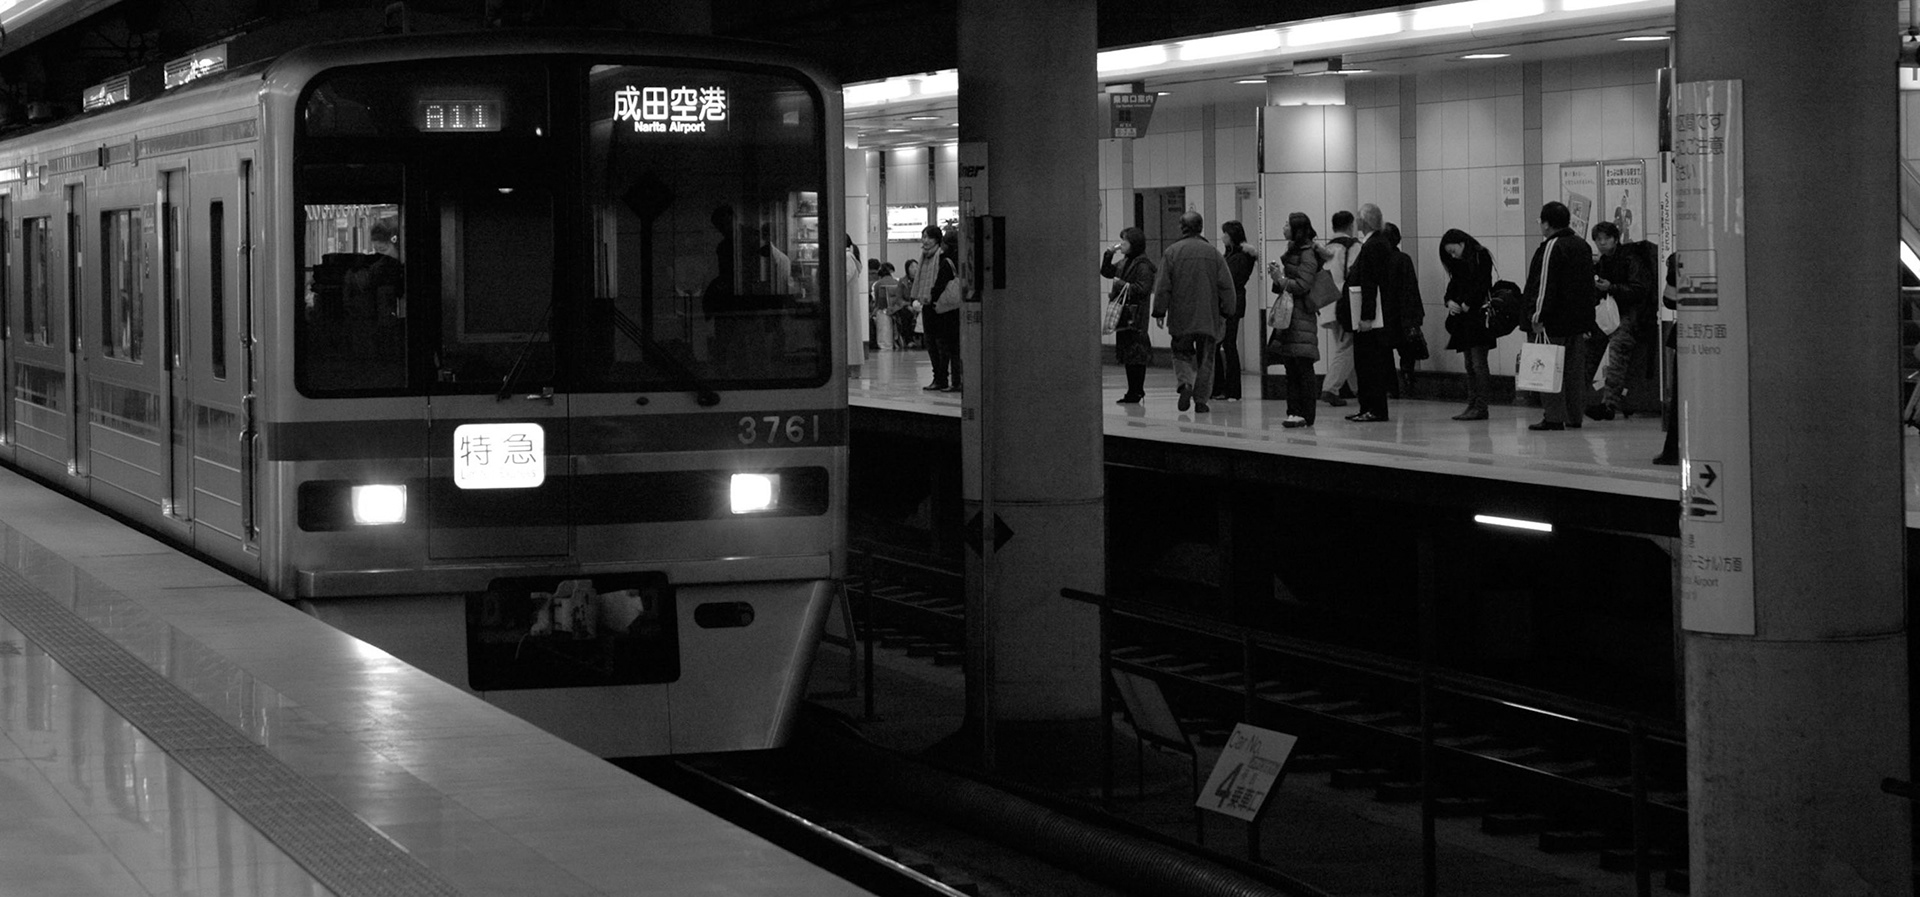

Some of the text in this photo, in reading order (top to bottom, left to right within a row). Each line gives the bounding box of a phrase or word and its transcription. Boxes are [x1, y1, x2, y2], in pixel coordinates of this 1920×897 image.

[426, 105, 485, 128] A11
[613, 85, 726, 121] 成田空港
[634, 121, 706, 134] Narita Airport
[738, 415, 819, 444] 3761
[460, 434, 537, 466] 特急
[1215, 763, 1244, 808] 4
